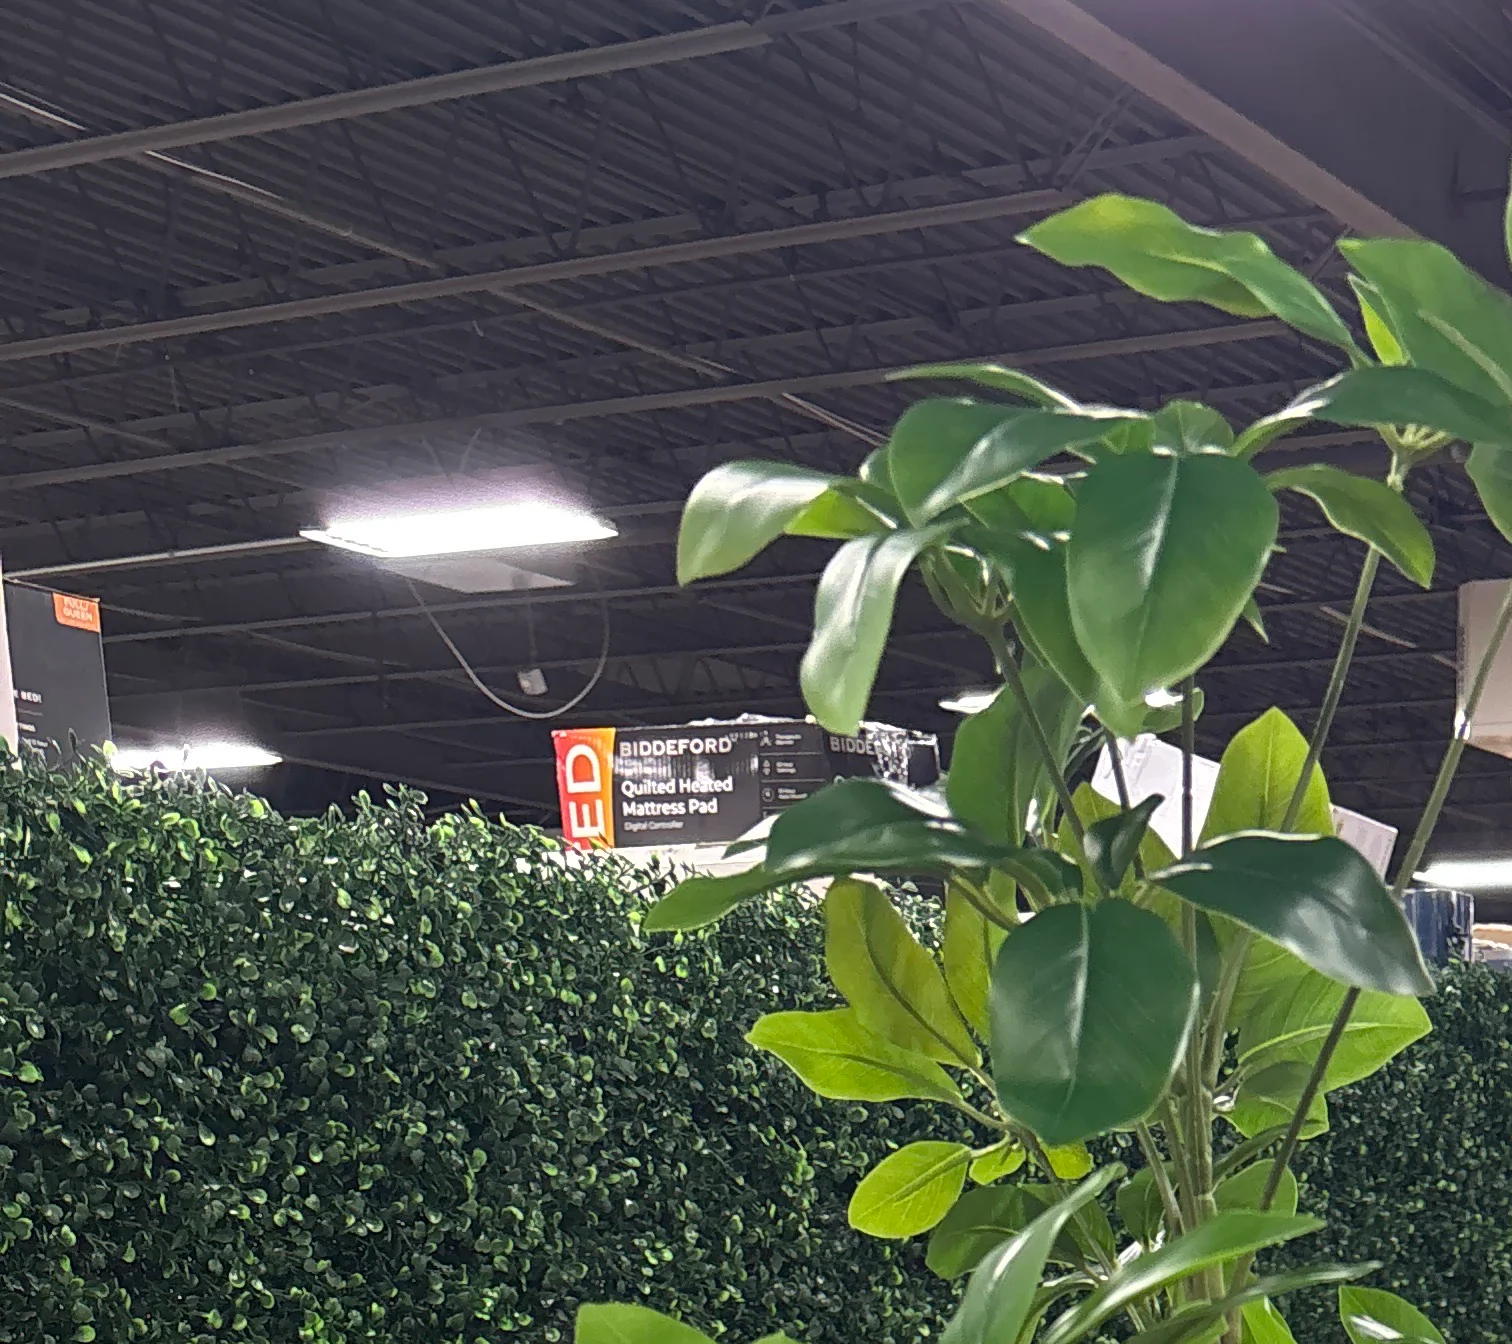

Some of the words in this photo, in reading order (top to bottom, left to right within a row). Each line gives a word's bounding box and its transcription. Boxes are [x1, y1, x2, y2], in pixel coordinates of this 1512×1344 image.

[620, 737, 732, 757] BIDDEFORD
[621, 779, 676, 798] Quilted
[679, 776, 733, 793] Heated
[622, 801, 686, 817] Mattress
[689, 798, 719, 814] Pad
